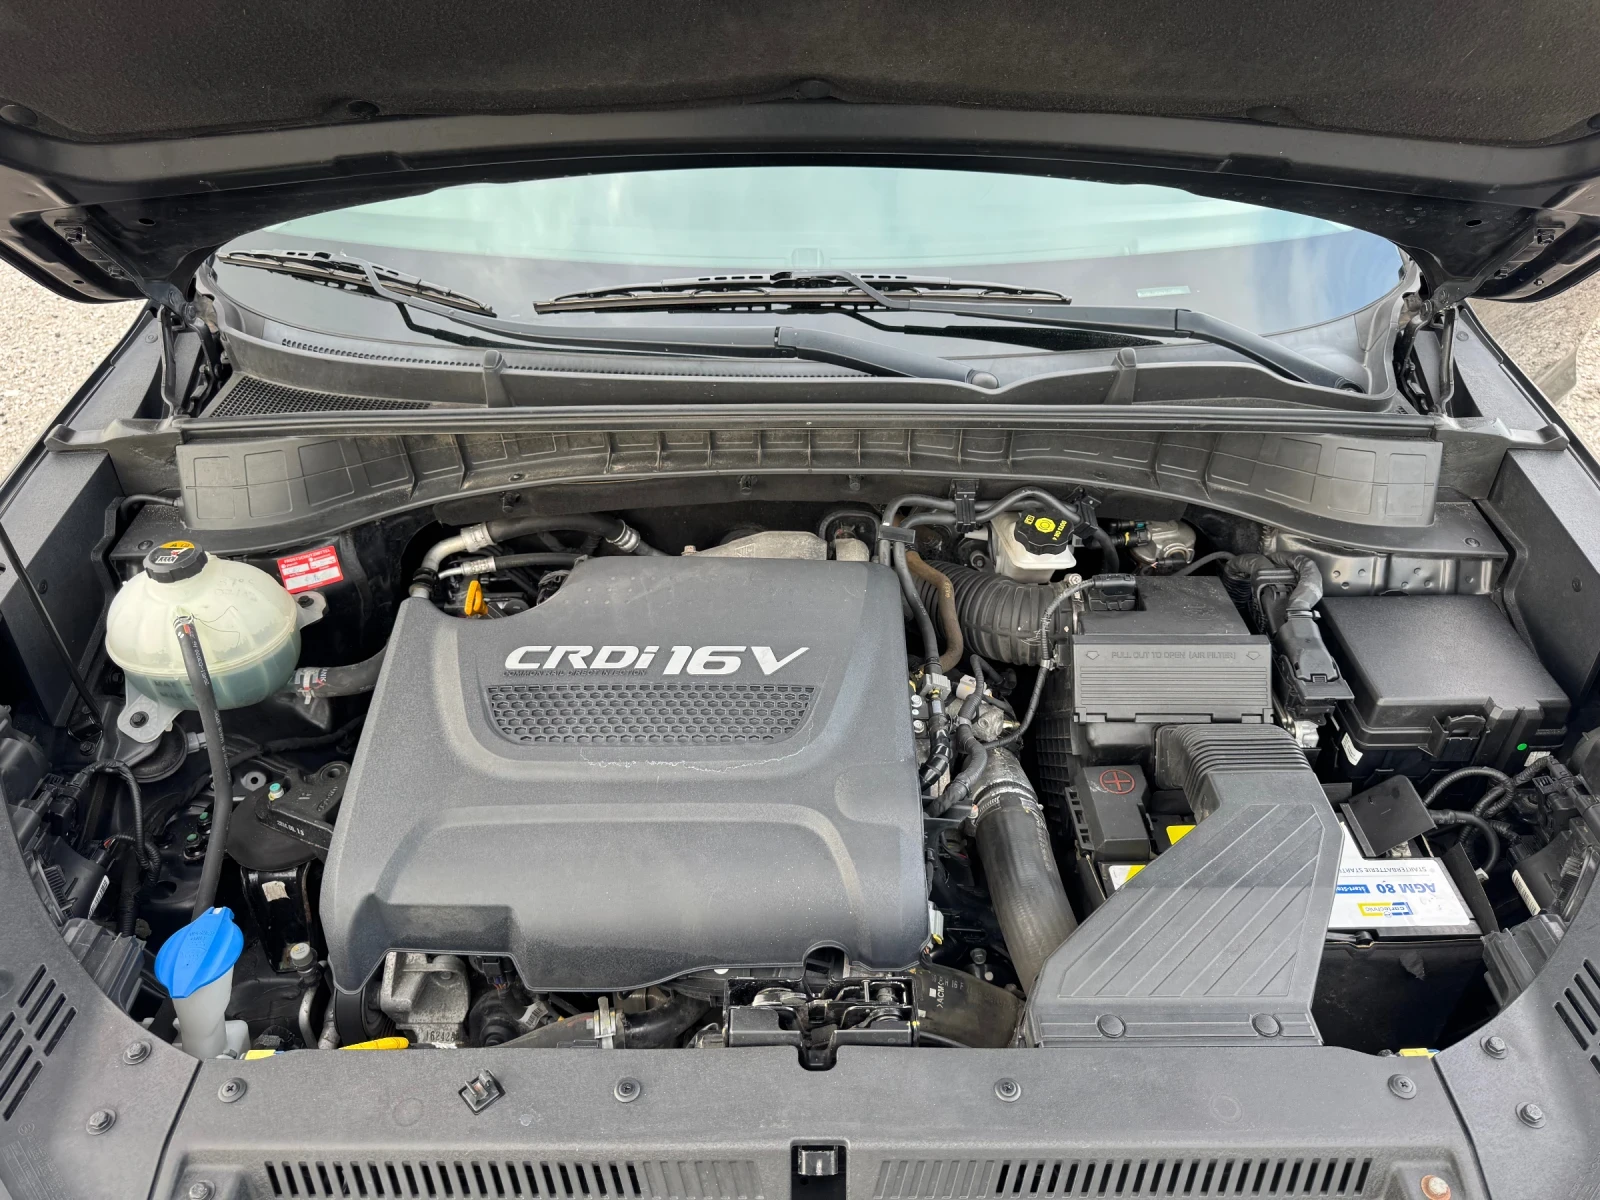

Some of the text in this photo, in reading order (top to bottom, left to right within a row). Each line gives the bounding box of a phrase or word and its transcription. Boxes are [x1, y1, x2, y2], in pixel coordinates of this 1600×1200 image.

[1111, 651, 1132, 659] PULL
[1133, 651, 1150, 659] OUT
[1151, 651, 1162, 659] TO
[1163, 651, 1186, 659] OPEN
[504, 645, 811, 676] CRDi 16V
[503, 669, 543, 677] COMMON
[601, 669, 648, 677] INJECTION
[1376, 884, 1396, 894] 80
[1398, 883, 1436, 893] AGM
